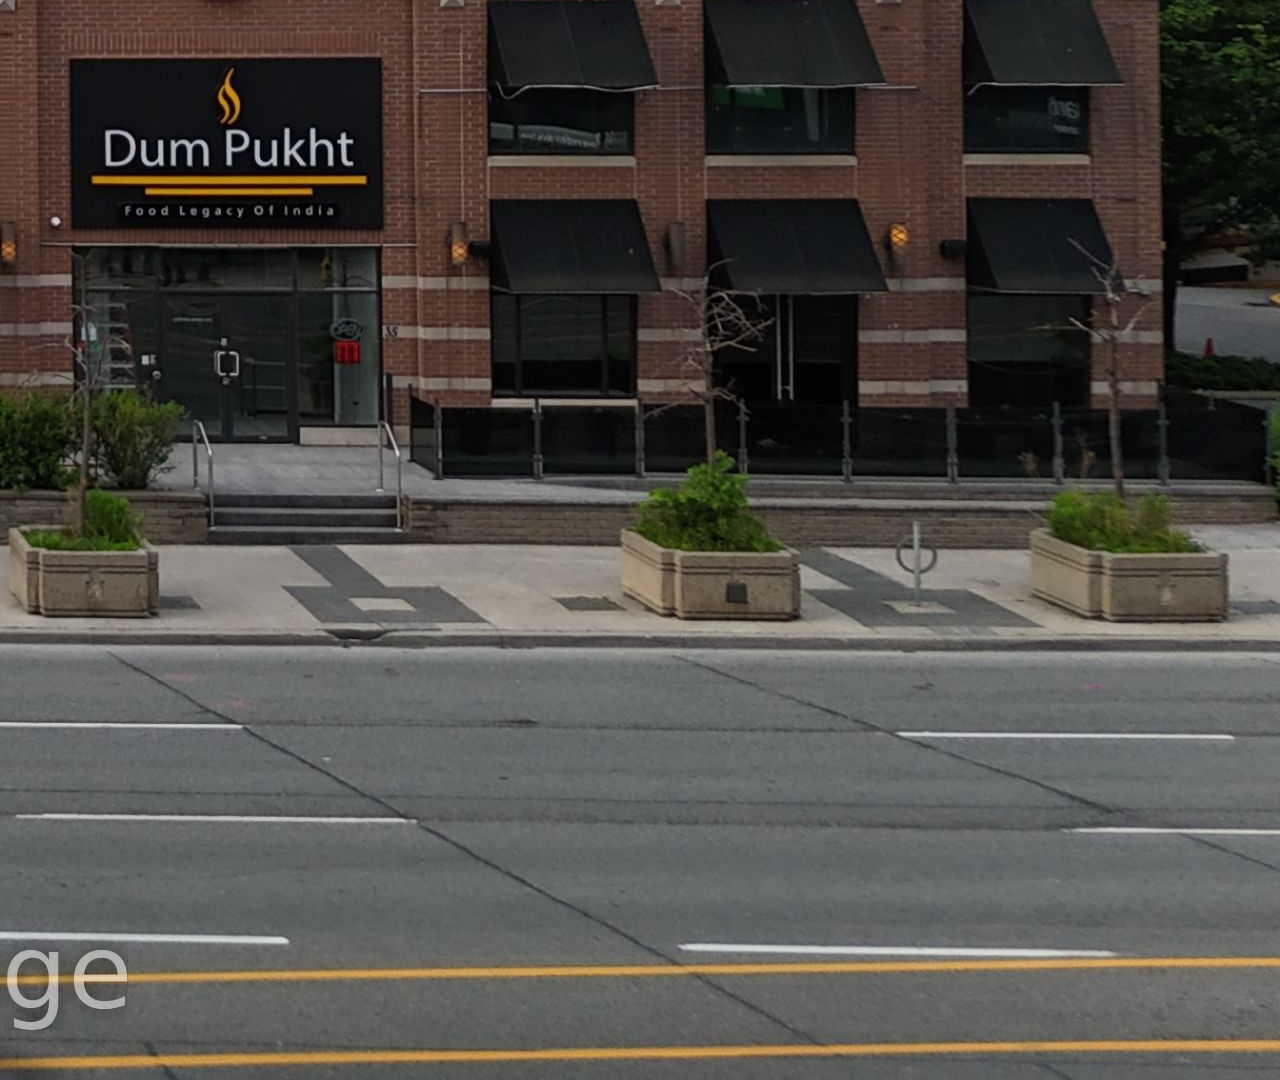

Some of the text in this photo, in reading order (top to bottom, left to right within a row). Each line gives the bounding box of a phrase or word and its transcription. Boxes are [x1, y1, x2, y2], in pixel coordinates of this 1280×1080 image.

[104, 127, 355, 167] Dum Pukht
[125, 205, 334, 219] Food Legacy Of India
